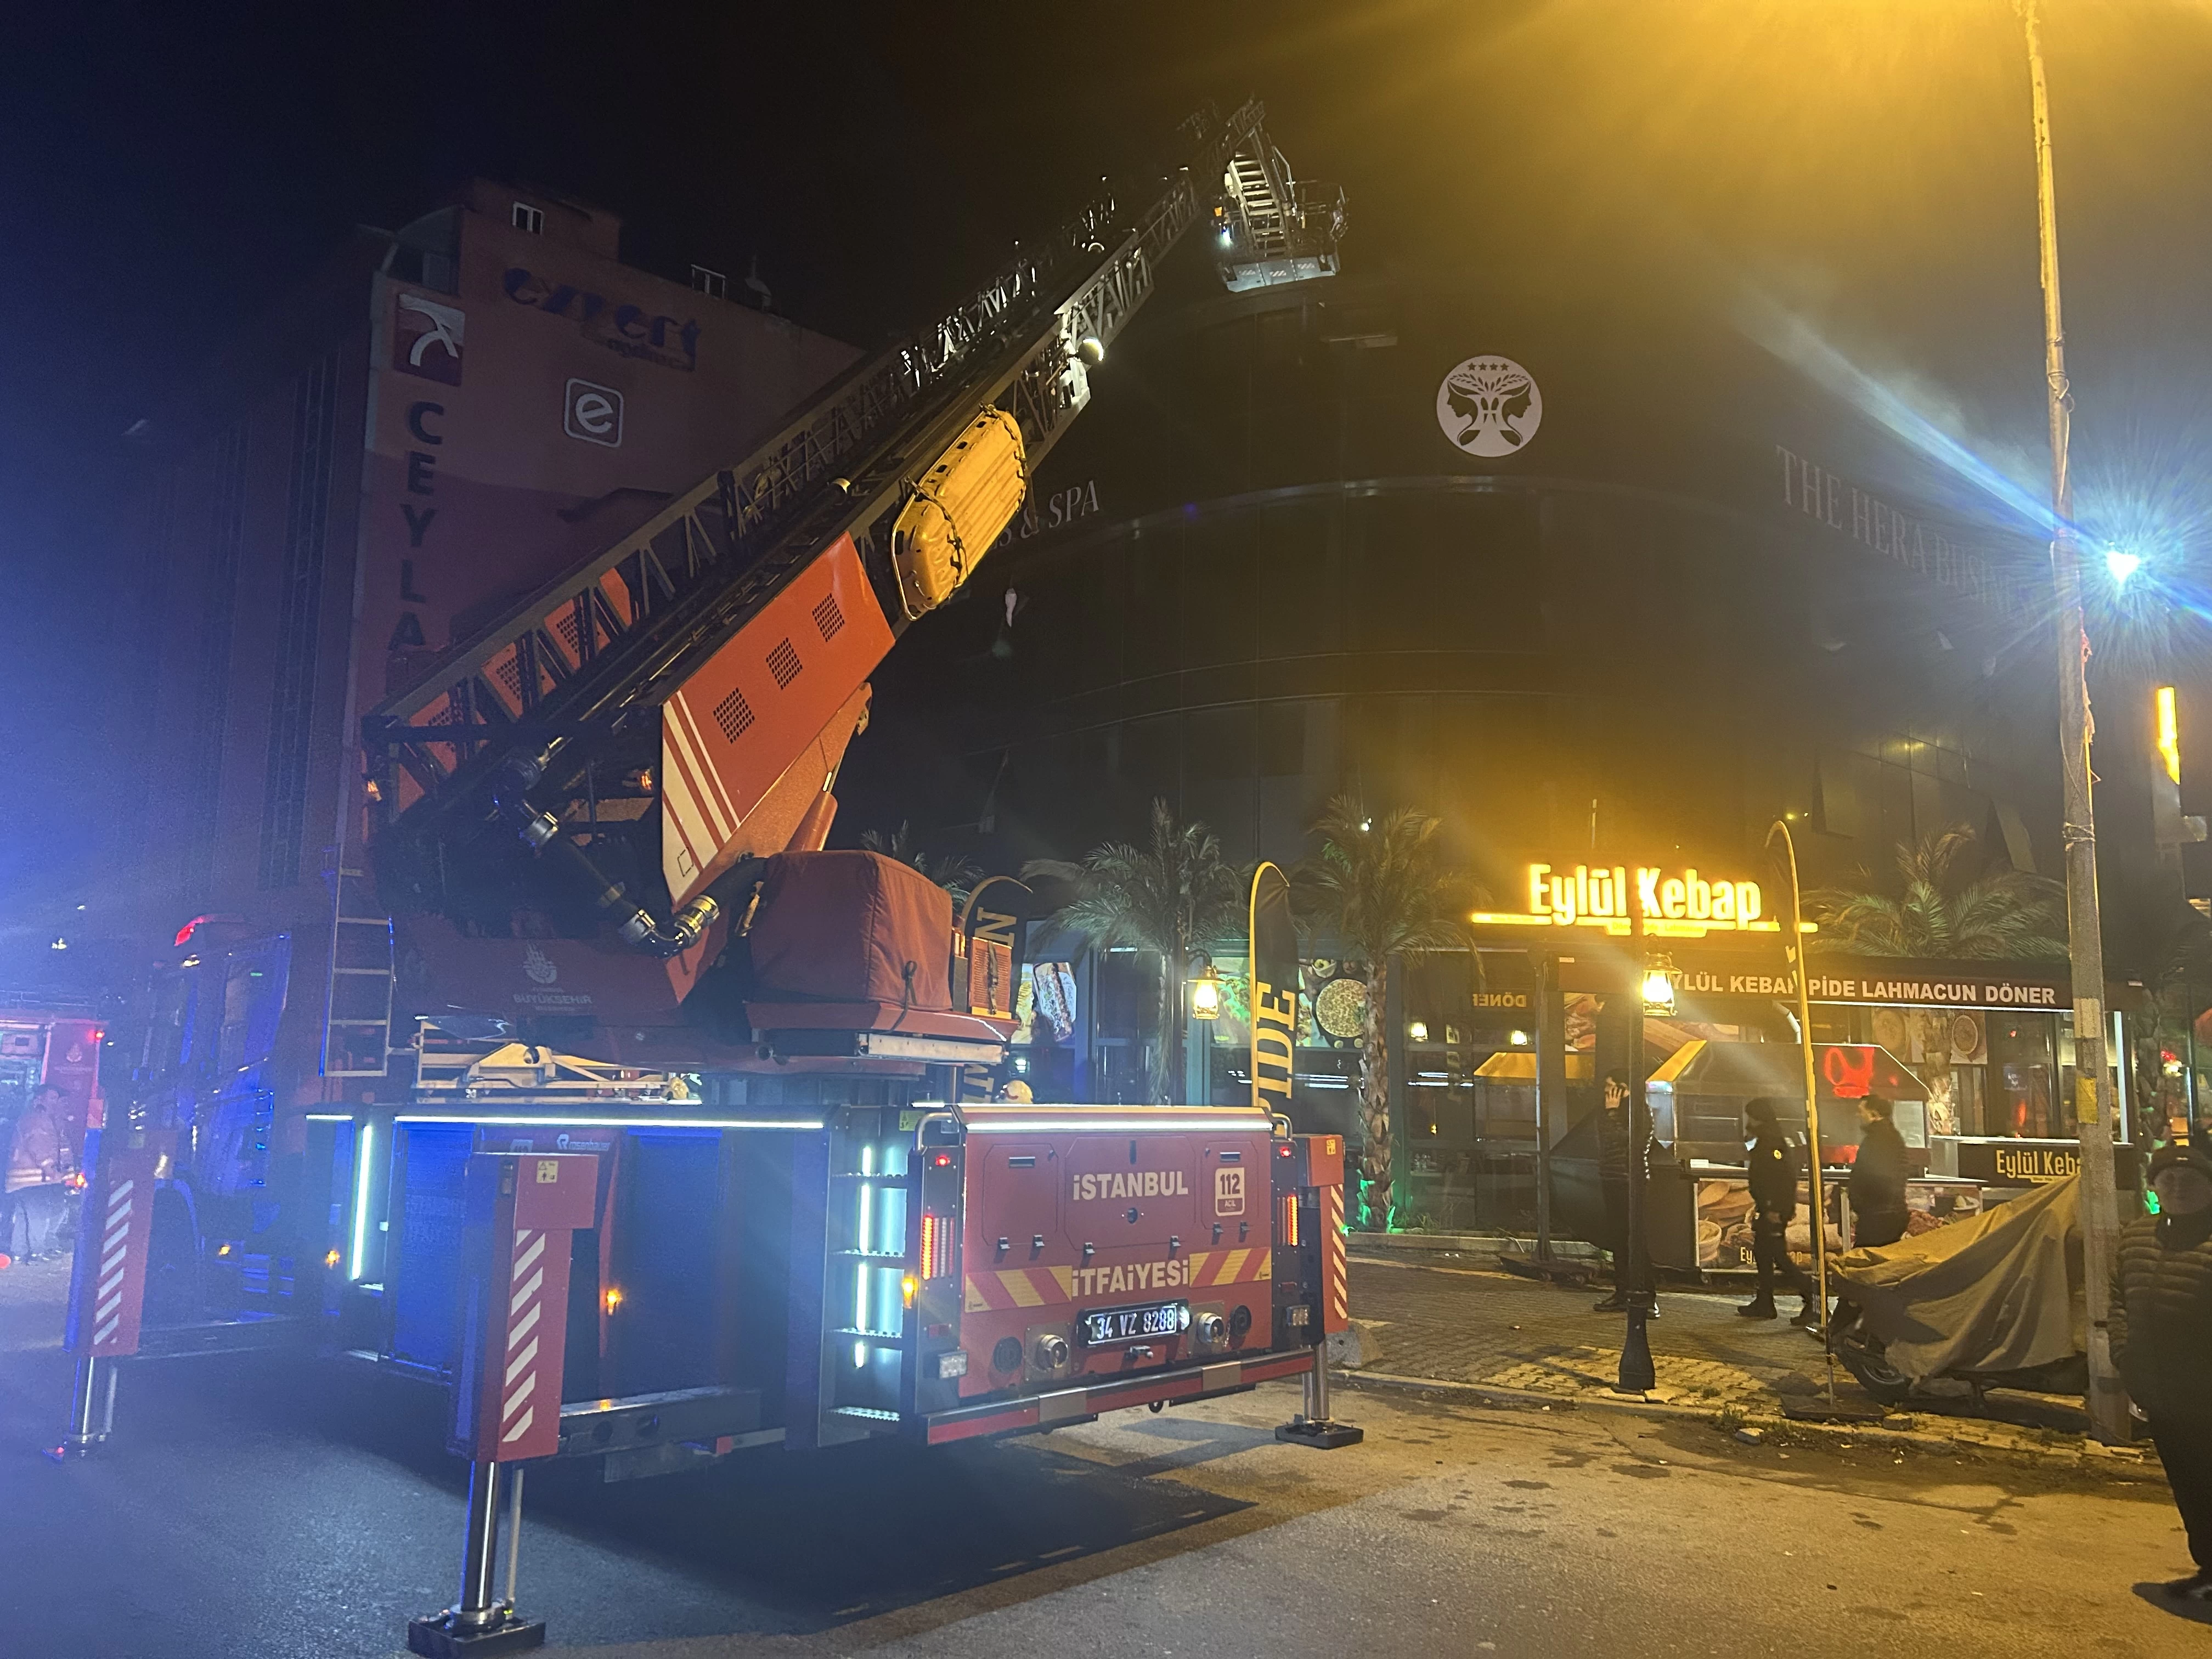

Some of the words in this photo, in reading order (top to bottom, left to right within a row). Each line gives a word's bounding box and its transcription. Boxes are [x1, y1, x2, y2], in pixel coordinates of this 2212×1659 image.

[1048, 479, 1099, 528] SPA
[1775, 443, 1844, 531] THE
[1851, 487, 1928, 576] HERA
[1529, 864, 1627, 926] Eylül
[1637, 867, 1762, 931] Kebap
[1673, 971, 1724, 992] YLÜL
[1809, 976, 1855, 997] PİDE
[1862, 981, 1977, 1001] LAHMACUN
[1985, 982, 2056, 1005] DÖNER
[1996, 1149, 2039, 1179] Eylül
[1220, 1173, 1240, 1195] 112
[1097, 1316, 1113, 1339] 34
[1120, 1313, 1137, 1336] VZ
[1143, 1309, 1175, 1333] 8288
